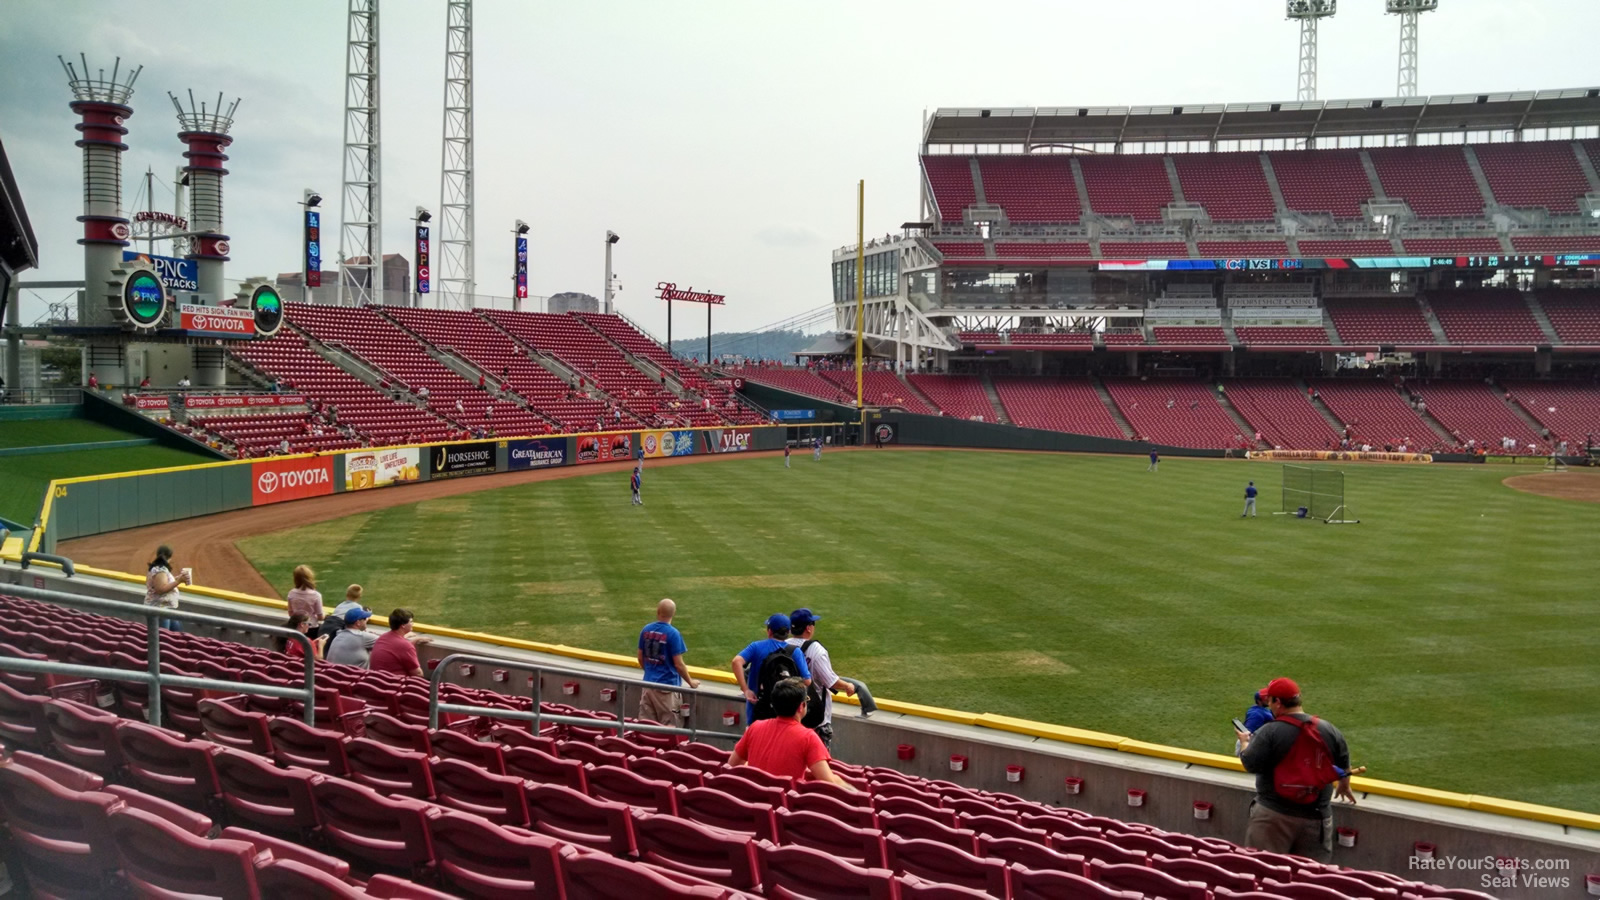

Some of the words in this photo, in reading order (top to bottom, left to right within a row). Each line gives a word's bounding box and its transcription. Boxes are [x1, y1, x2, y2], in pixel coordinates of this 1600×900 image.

[153, 258, 188, 279] PNC
[1252, 260, 1268, 268] VS
[163, 277, 197, 290] STACKS
[141, 292, 159, 303] PNC
[196, 306, 210, 314] HITS
[239, 310, 253, 318] WINS
[208, 317, 245, 331] TOYOTA
[147, 399, 168, 407] TOYOTA
[195, 398, 216, 406] TOYOTA
[286, 396, 304, 404] TOYOTA
[380, 454, 389, 463] LIVE
[389, 452, 398, 460] LIFE
[448, 450, 490, 463] HORSESHOE
[512, 449, 534, 459] GREAT
[530, 450, 563, 460] AMERICAN
[384, 457, 407, 469] UNFILTERED
[280, 468, 329, 488] TOYOTA
